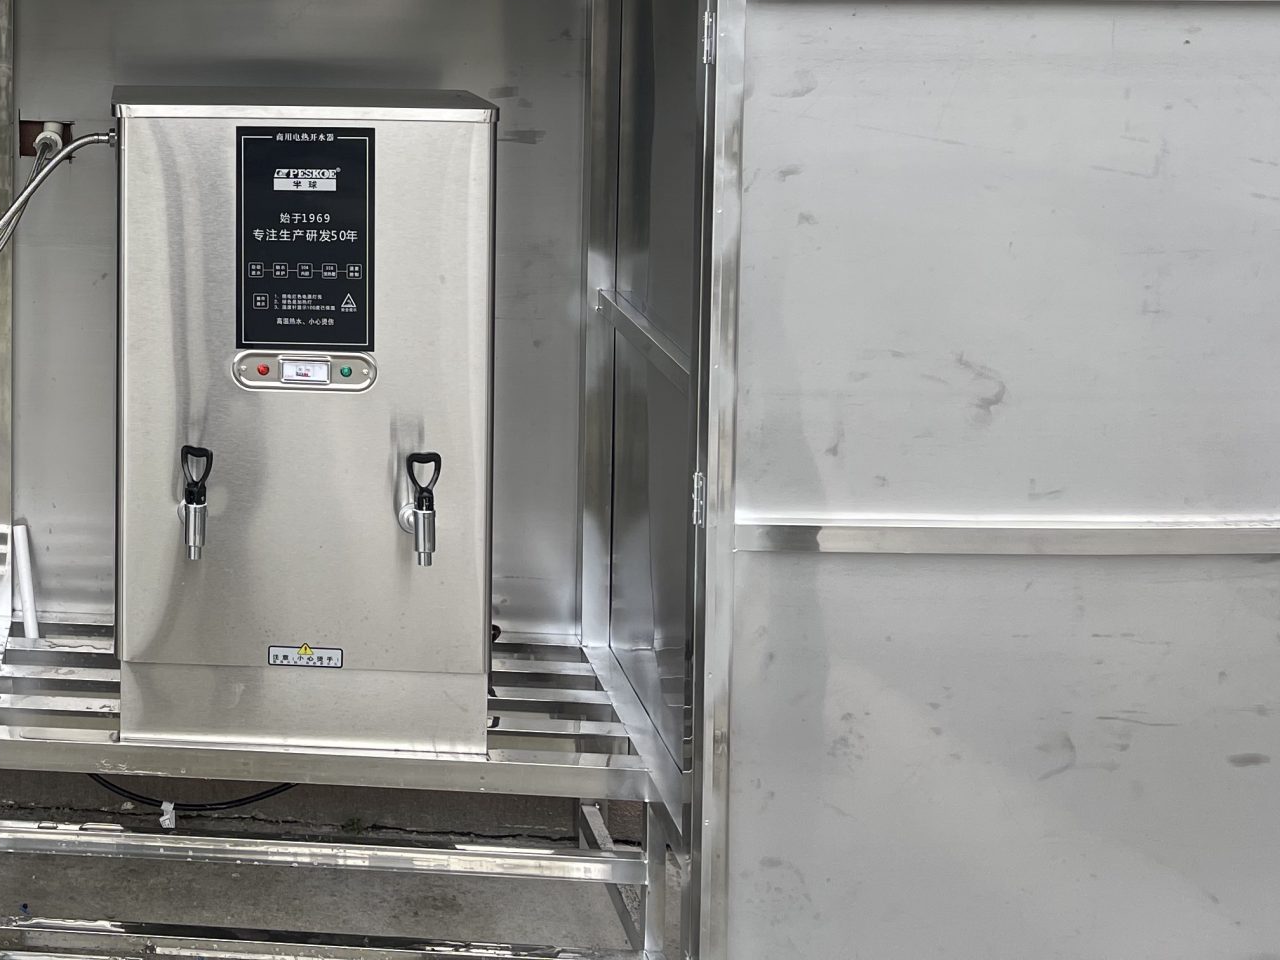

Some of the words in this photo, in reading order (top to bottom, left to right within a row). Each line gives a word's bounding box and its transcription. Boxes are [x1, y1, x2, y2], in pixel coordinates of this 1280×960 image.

[280, 212, 331, 224] 始于1969
[253, 229, 358, 242] 专注生产研发50年
